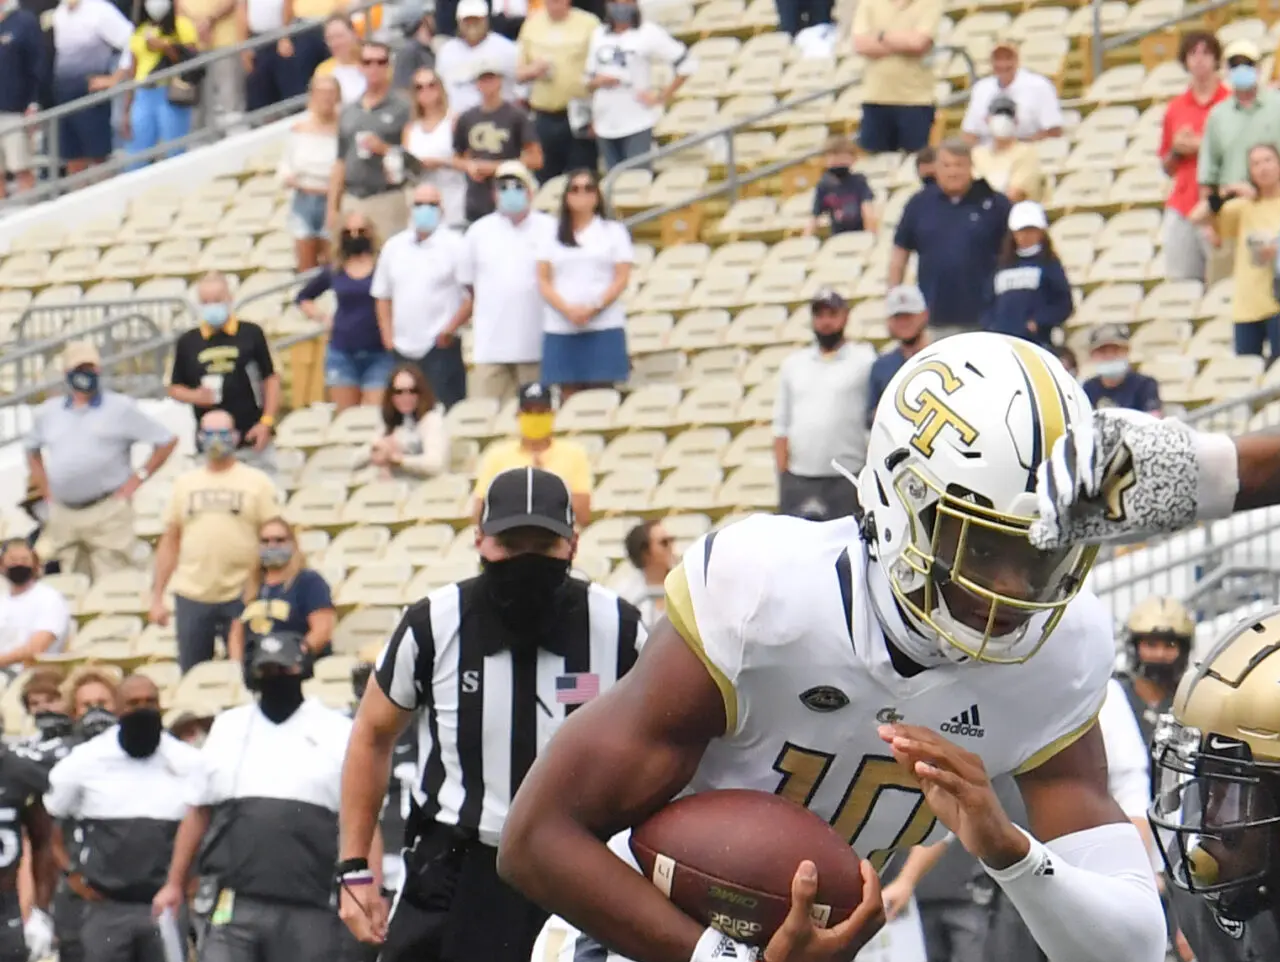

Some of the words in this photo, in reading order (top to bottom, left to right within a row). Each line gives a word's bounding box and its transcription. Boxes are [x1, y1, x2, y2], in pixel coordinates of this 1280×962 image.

[894, 360, 979, 459] GT
[461, 670, 480, 693] S
[940, 721, 985, 738] adidas
[772, 741, 937, 876] 10
